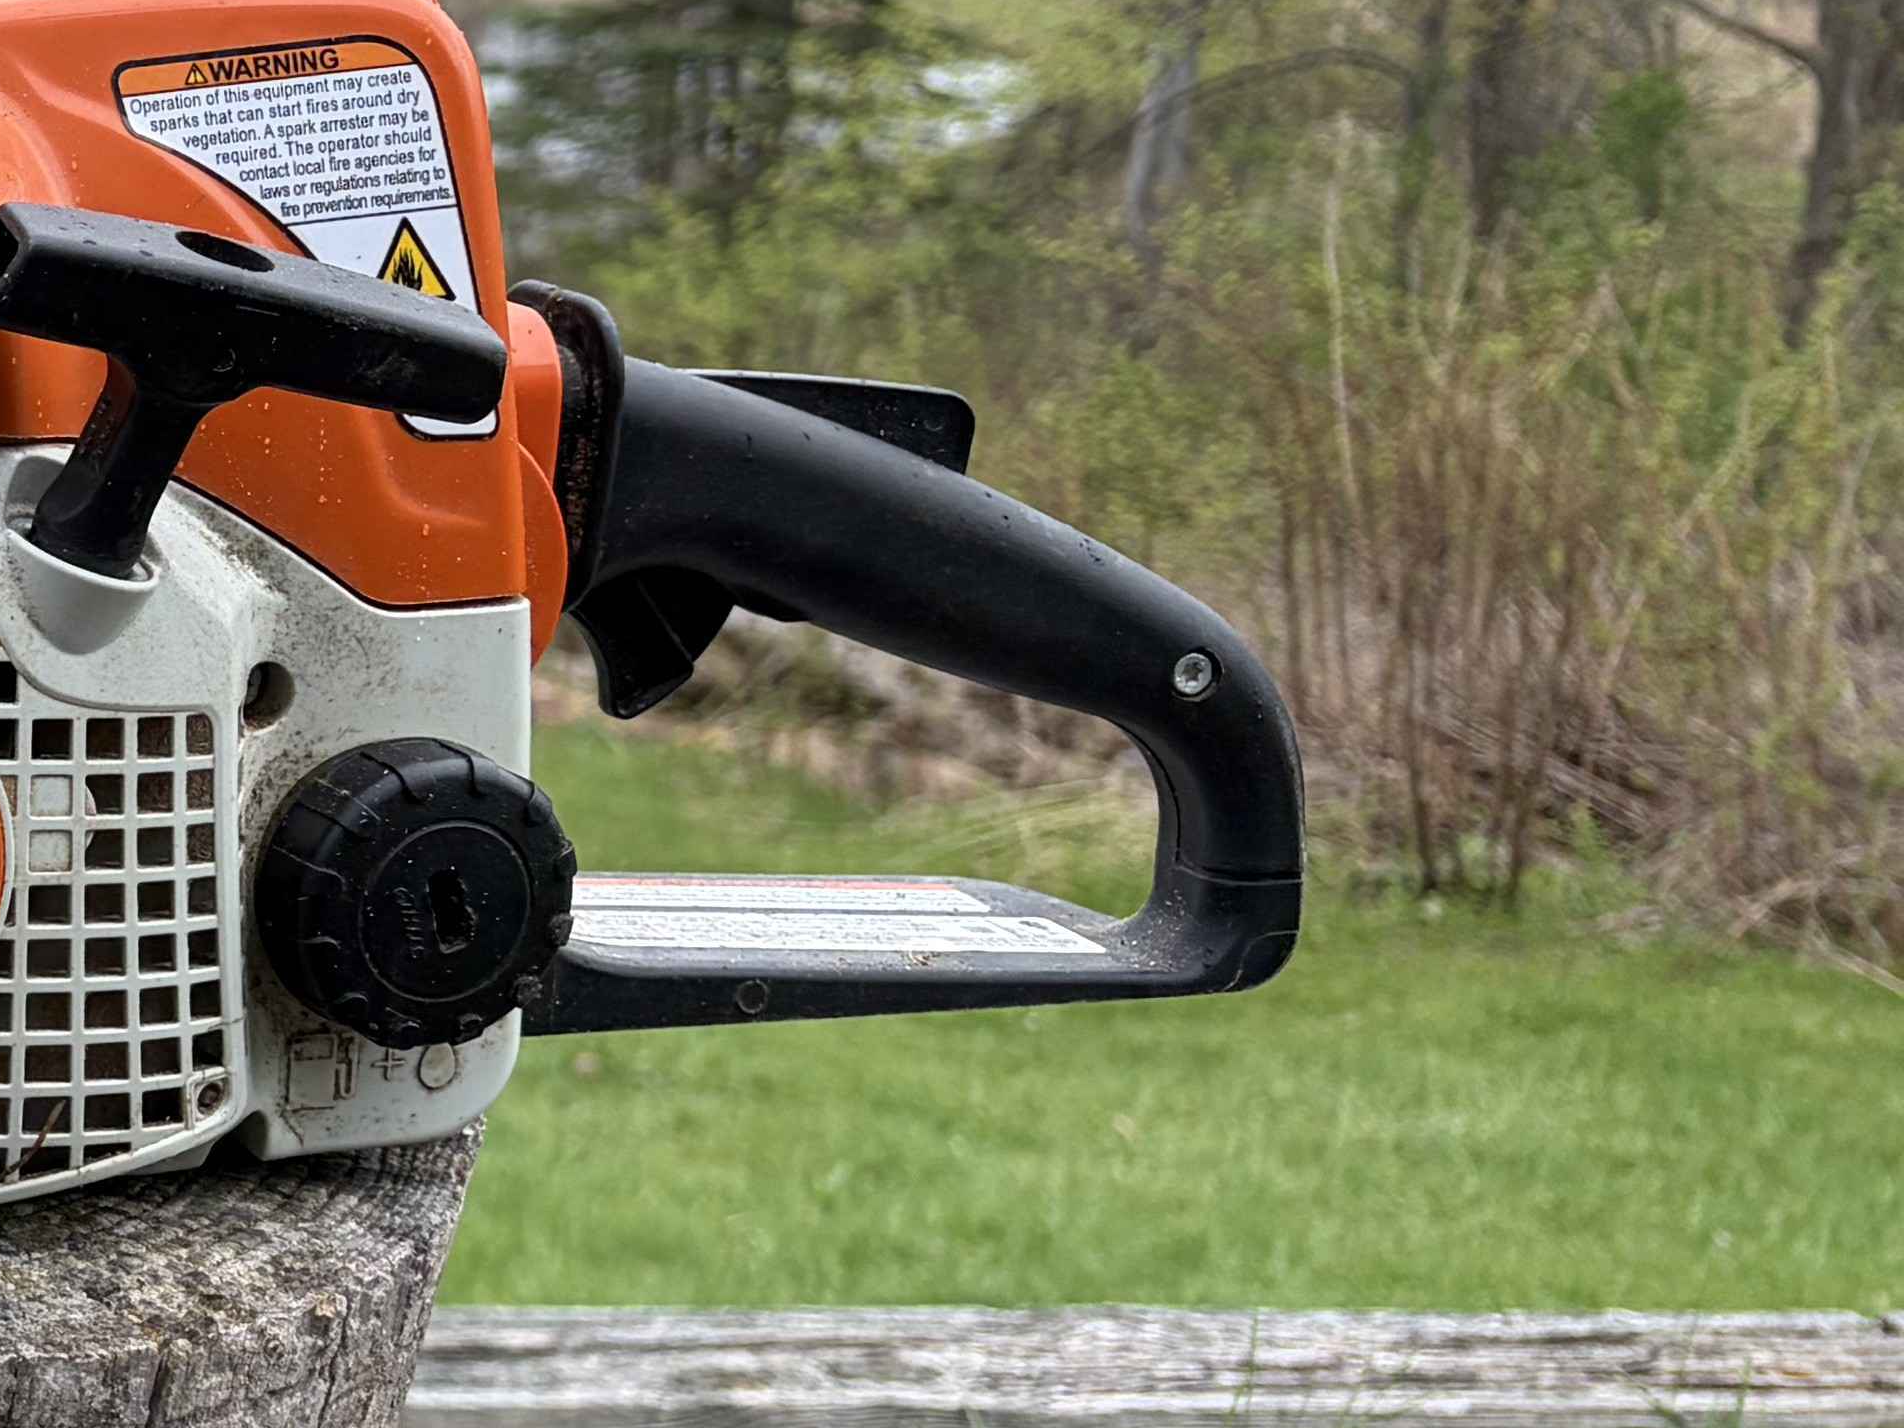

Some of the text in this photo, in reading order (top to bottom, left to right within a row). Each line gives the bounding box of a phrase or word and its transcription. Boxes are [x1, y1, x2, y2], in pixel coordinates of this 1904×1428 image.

[208, 49, 339, 81] WARNING
[130, 70, 411, 117] Operation of this equipment may create
[150, 88, 420, 135] sparks that can start fires around dry
[182, 108, 429, 150] vegetation. A spark arrester may be
[215, 126, 431, 166] required. The operator should
[239, 146, 436, 182] contact local fire agencies for
[260, 166, 446, 200] laws or regulations relating to
[280, 202, 300, 217] fire
[303, 194, 367, 218] prevention
